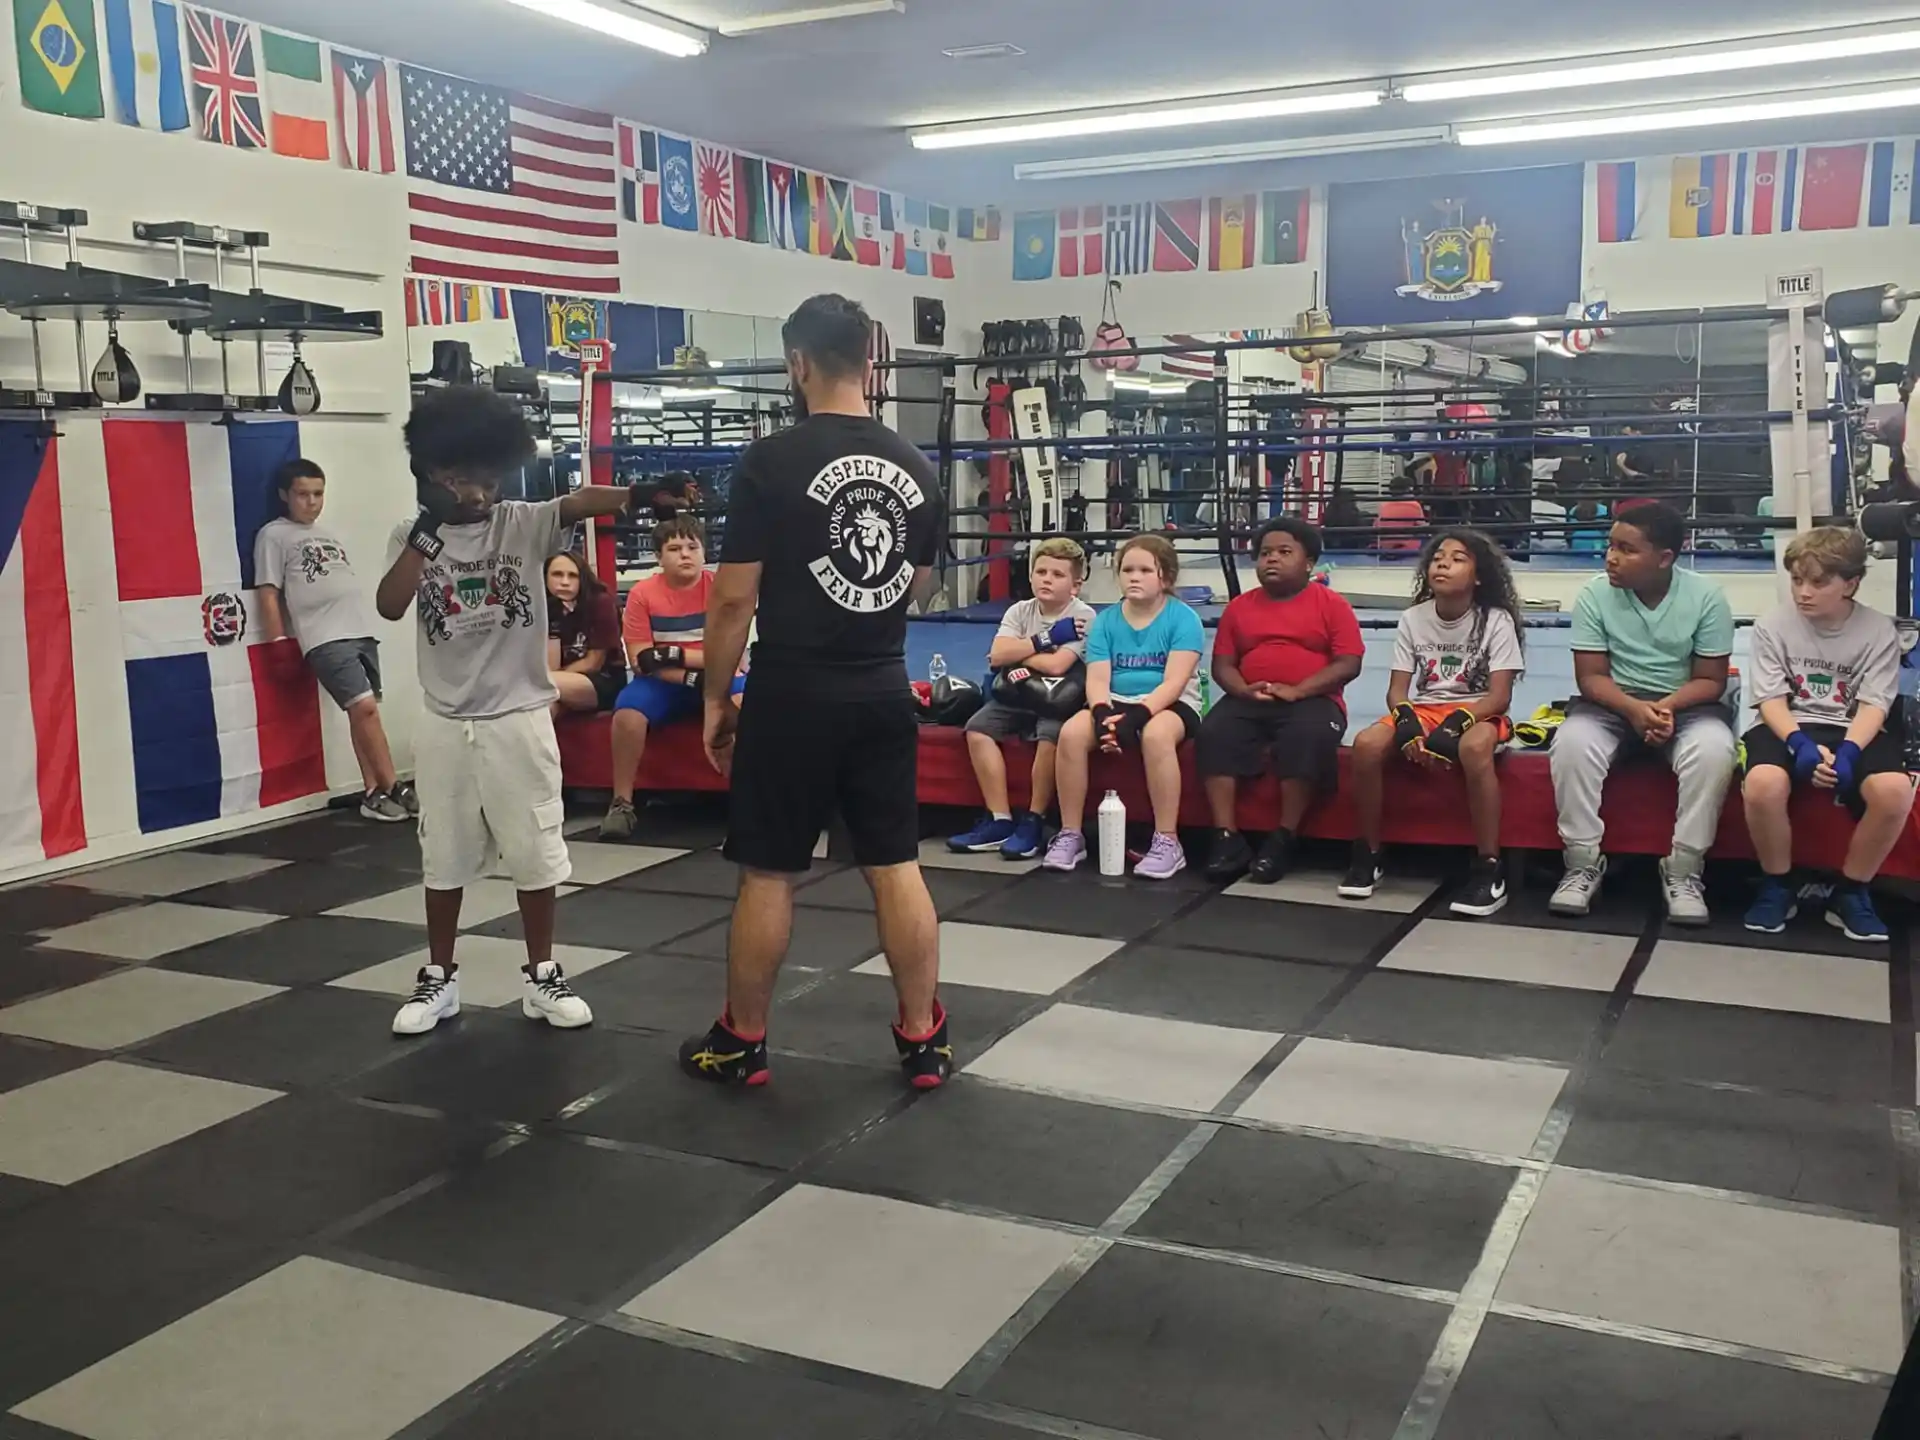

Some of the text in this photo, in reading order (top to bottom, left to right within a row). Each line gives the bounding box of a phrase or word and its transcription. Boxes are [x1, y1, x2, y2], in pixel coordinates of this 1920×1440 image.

[1779, 276, 1810, 293] TITLE
[583, 347, 601, 358] TITLE
[97, 371, 116, 381] TITLE
[1794, 345, 1803, 410] TITLE
[35, 392, 54, 404] TITLE
[295, 386, 312, 396] TITLE
[813, 459, 919, 507] RESPECT ALL
[829, 487, 907, 553] LIONS' PRIDE BOXING
[415, 531, 441, 554] TITLE
[817, 564, 911, 609] FEAR NONE
[1437, 643, 1464, 653] PRIDE
[1803, 658, 1835, 671] PRIDE
